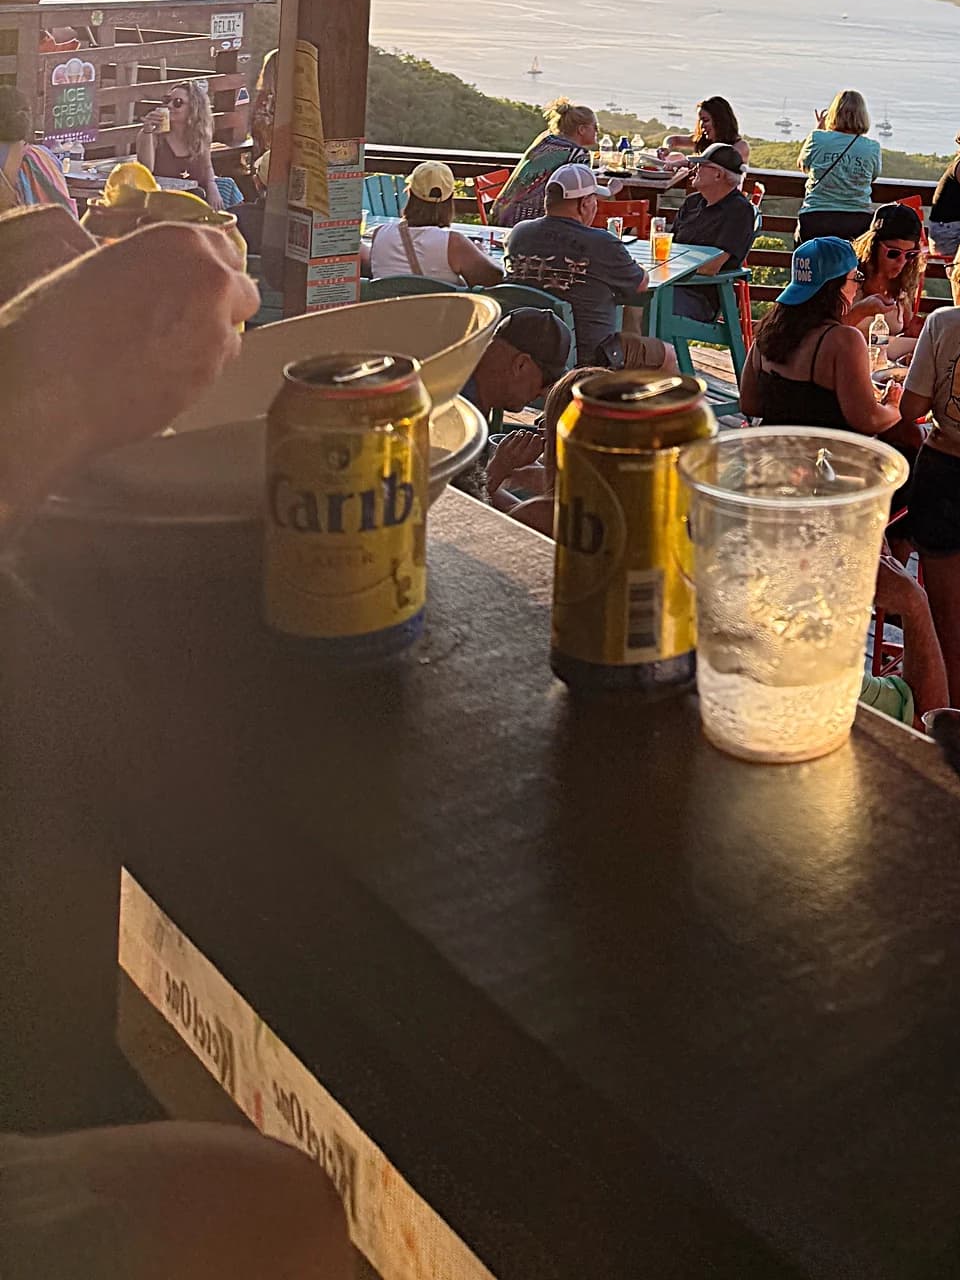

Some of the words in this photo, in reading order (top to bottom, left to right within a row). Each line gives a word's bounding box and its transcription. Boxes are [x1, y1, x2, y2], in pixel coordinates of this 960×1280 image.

[63, 87, 86, 103] ICE
[52, 102, 93, 117] CREAM
[54, 114, 92, 129] NOW
[271, 472, 415, 533] Carib
